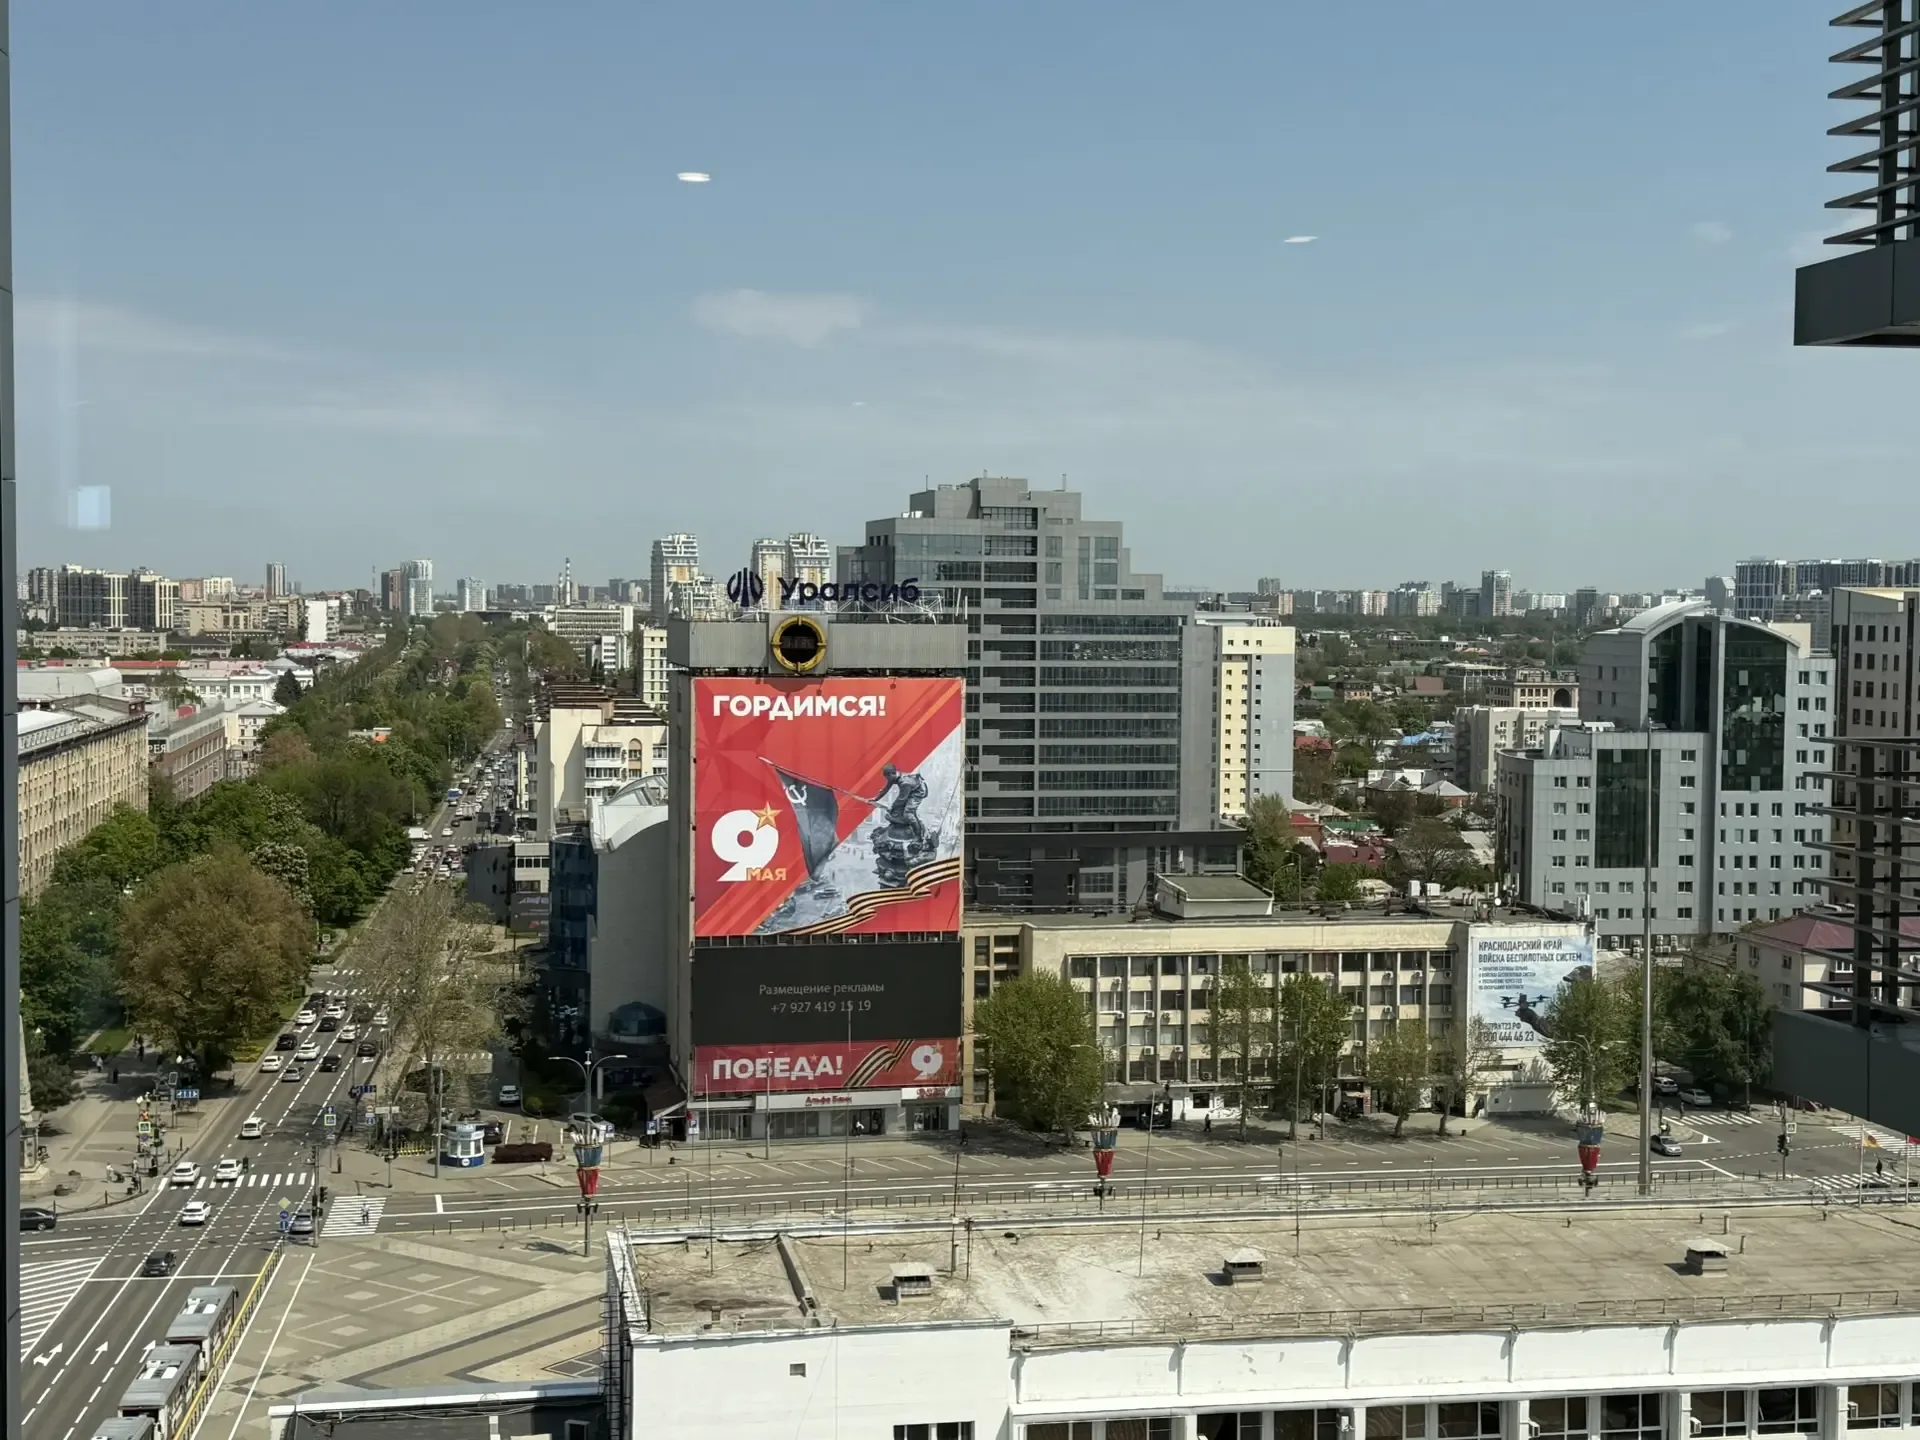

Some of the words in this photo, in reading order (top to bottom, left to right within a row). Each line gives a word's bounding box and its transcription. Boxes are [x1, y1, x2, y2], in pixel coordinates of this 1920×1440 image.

[777, 576, 920, 604] Уралсиб
[713, 695, 886, 721] ГОРДИМСЯ!
[711, 809, 779, 882] 9
[746, 867, 787, 882] МАЯ
[1478, 939, 1541, 952] КРАСНОДАРСКИЙ
[1543, 939, 1562, 950] КРАЙ
[1478, 953, 1504, 963] ВОЙСКА
[1506, 953, 1554, 962] БЕСПИЛОТНЫХ
[1556, 952, 1582, 962] СИСТЕМ
[759, 984, 832, 996] Размещение
[833, 983, 885, 996] рекламы
[771, 1002, 787, 1013] +7
[790, 1001, 811, 1013] 927
[814, 1000, 836, 1012] 419
[840, 1000, 854, 1012] 15
[857, 999, 872, 1011] 19
[1499, 1031, 1512, 1042] 444
[1514, 1031, 1524, 1042] 46
[1525, 1031, 1535, 1042] 23
[713, 1055, 843, 1081] ПОБЕДА!
[911, 1045, 943, 1081] 9
